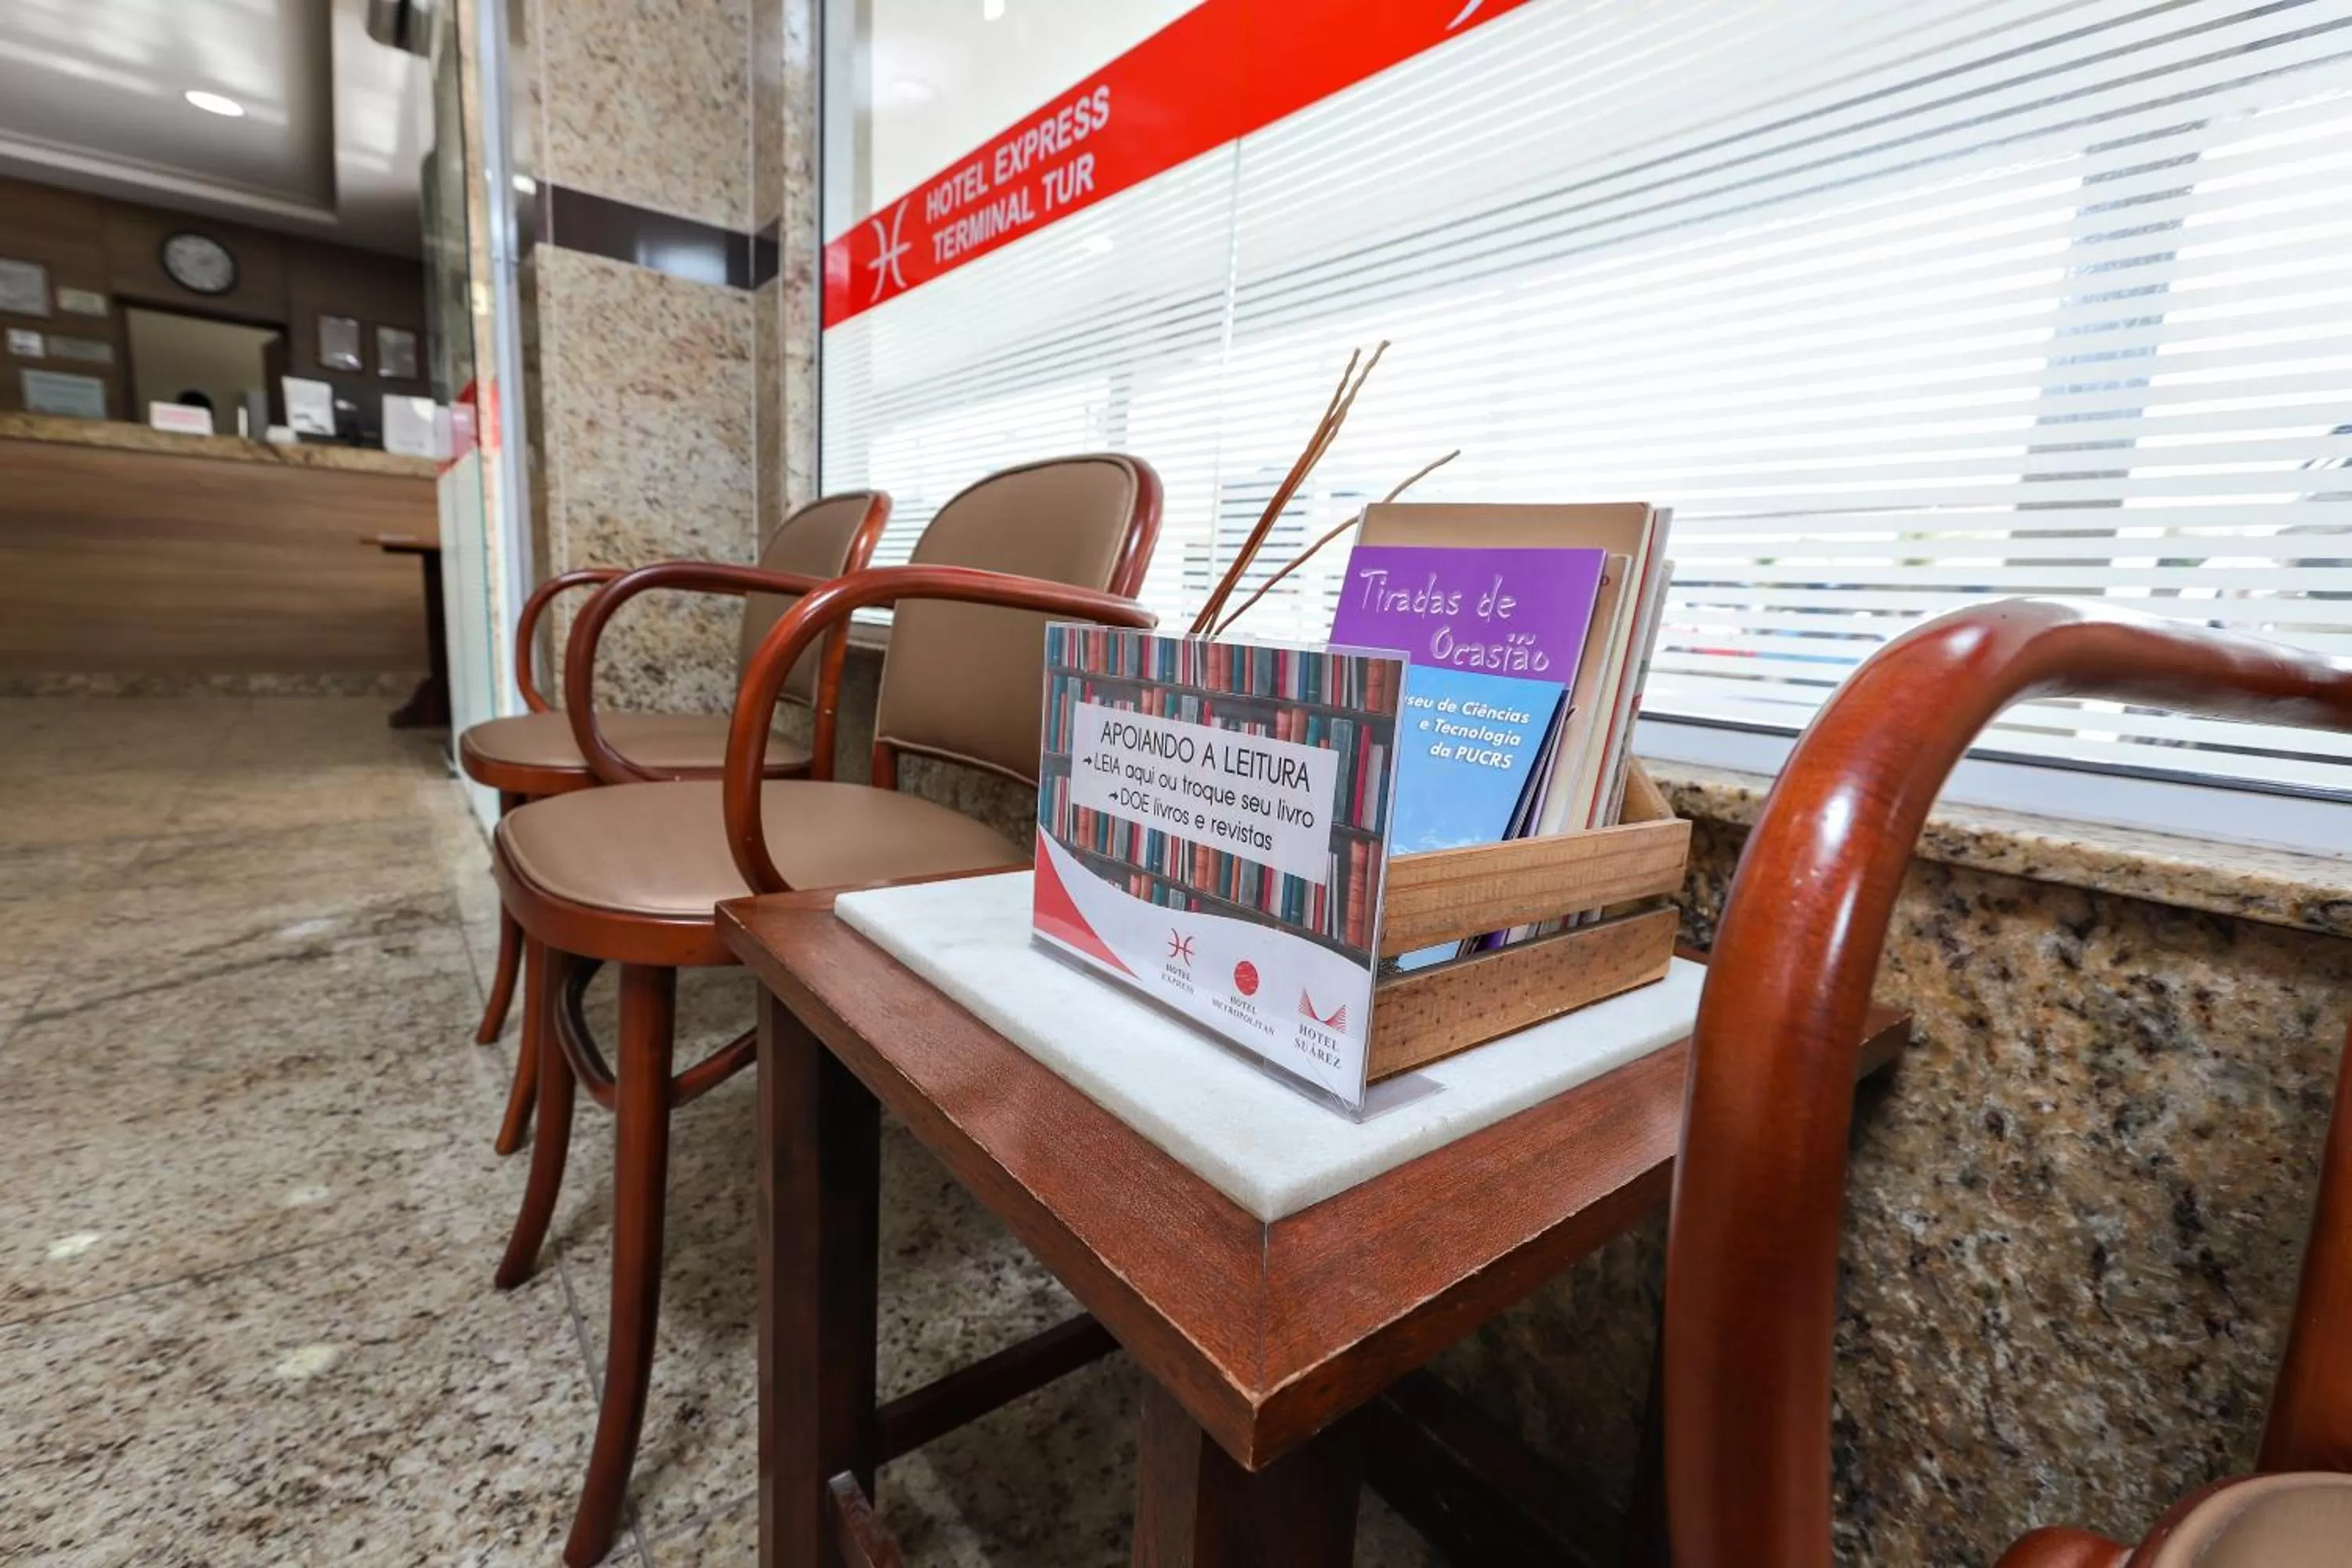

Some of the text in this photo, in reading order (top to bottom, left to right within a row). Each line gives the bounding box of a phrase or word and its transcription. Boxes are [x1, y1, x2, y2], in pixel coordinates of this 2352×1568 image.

[926, 85, 1110, 223] HOTEL EXPRESS
[933, 153, 1094, 264] TERMINAL TUR
[1359, 568, 1517, 619] Tiradas de
[1432, 626, 1550, 672] Ocasião
[1405, 695, 1530, 724] seu de Ciências
[1419, 718, 1521, 746] e Tecnologia
[1100, 720, 1311, 793] APOIANDO A LEITURA
[1430, 742, 1513, 769] da PUCRS
[1094, 752, 1315, 829] LEIA aqui ou troque seu livro
[1120, 788, 1273, 851] DOE livros e revistas
[1166, 963, 1192, 982] HOTEL
[1212, 998, 1276, 1036] METROPOLITAN
[1229, 995, 1258, 1015] HOTEL
[1299, 1023, 1340, 1051] HOTEL
